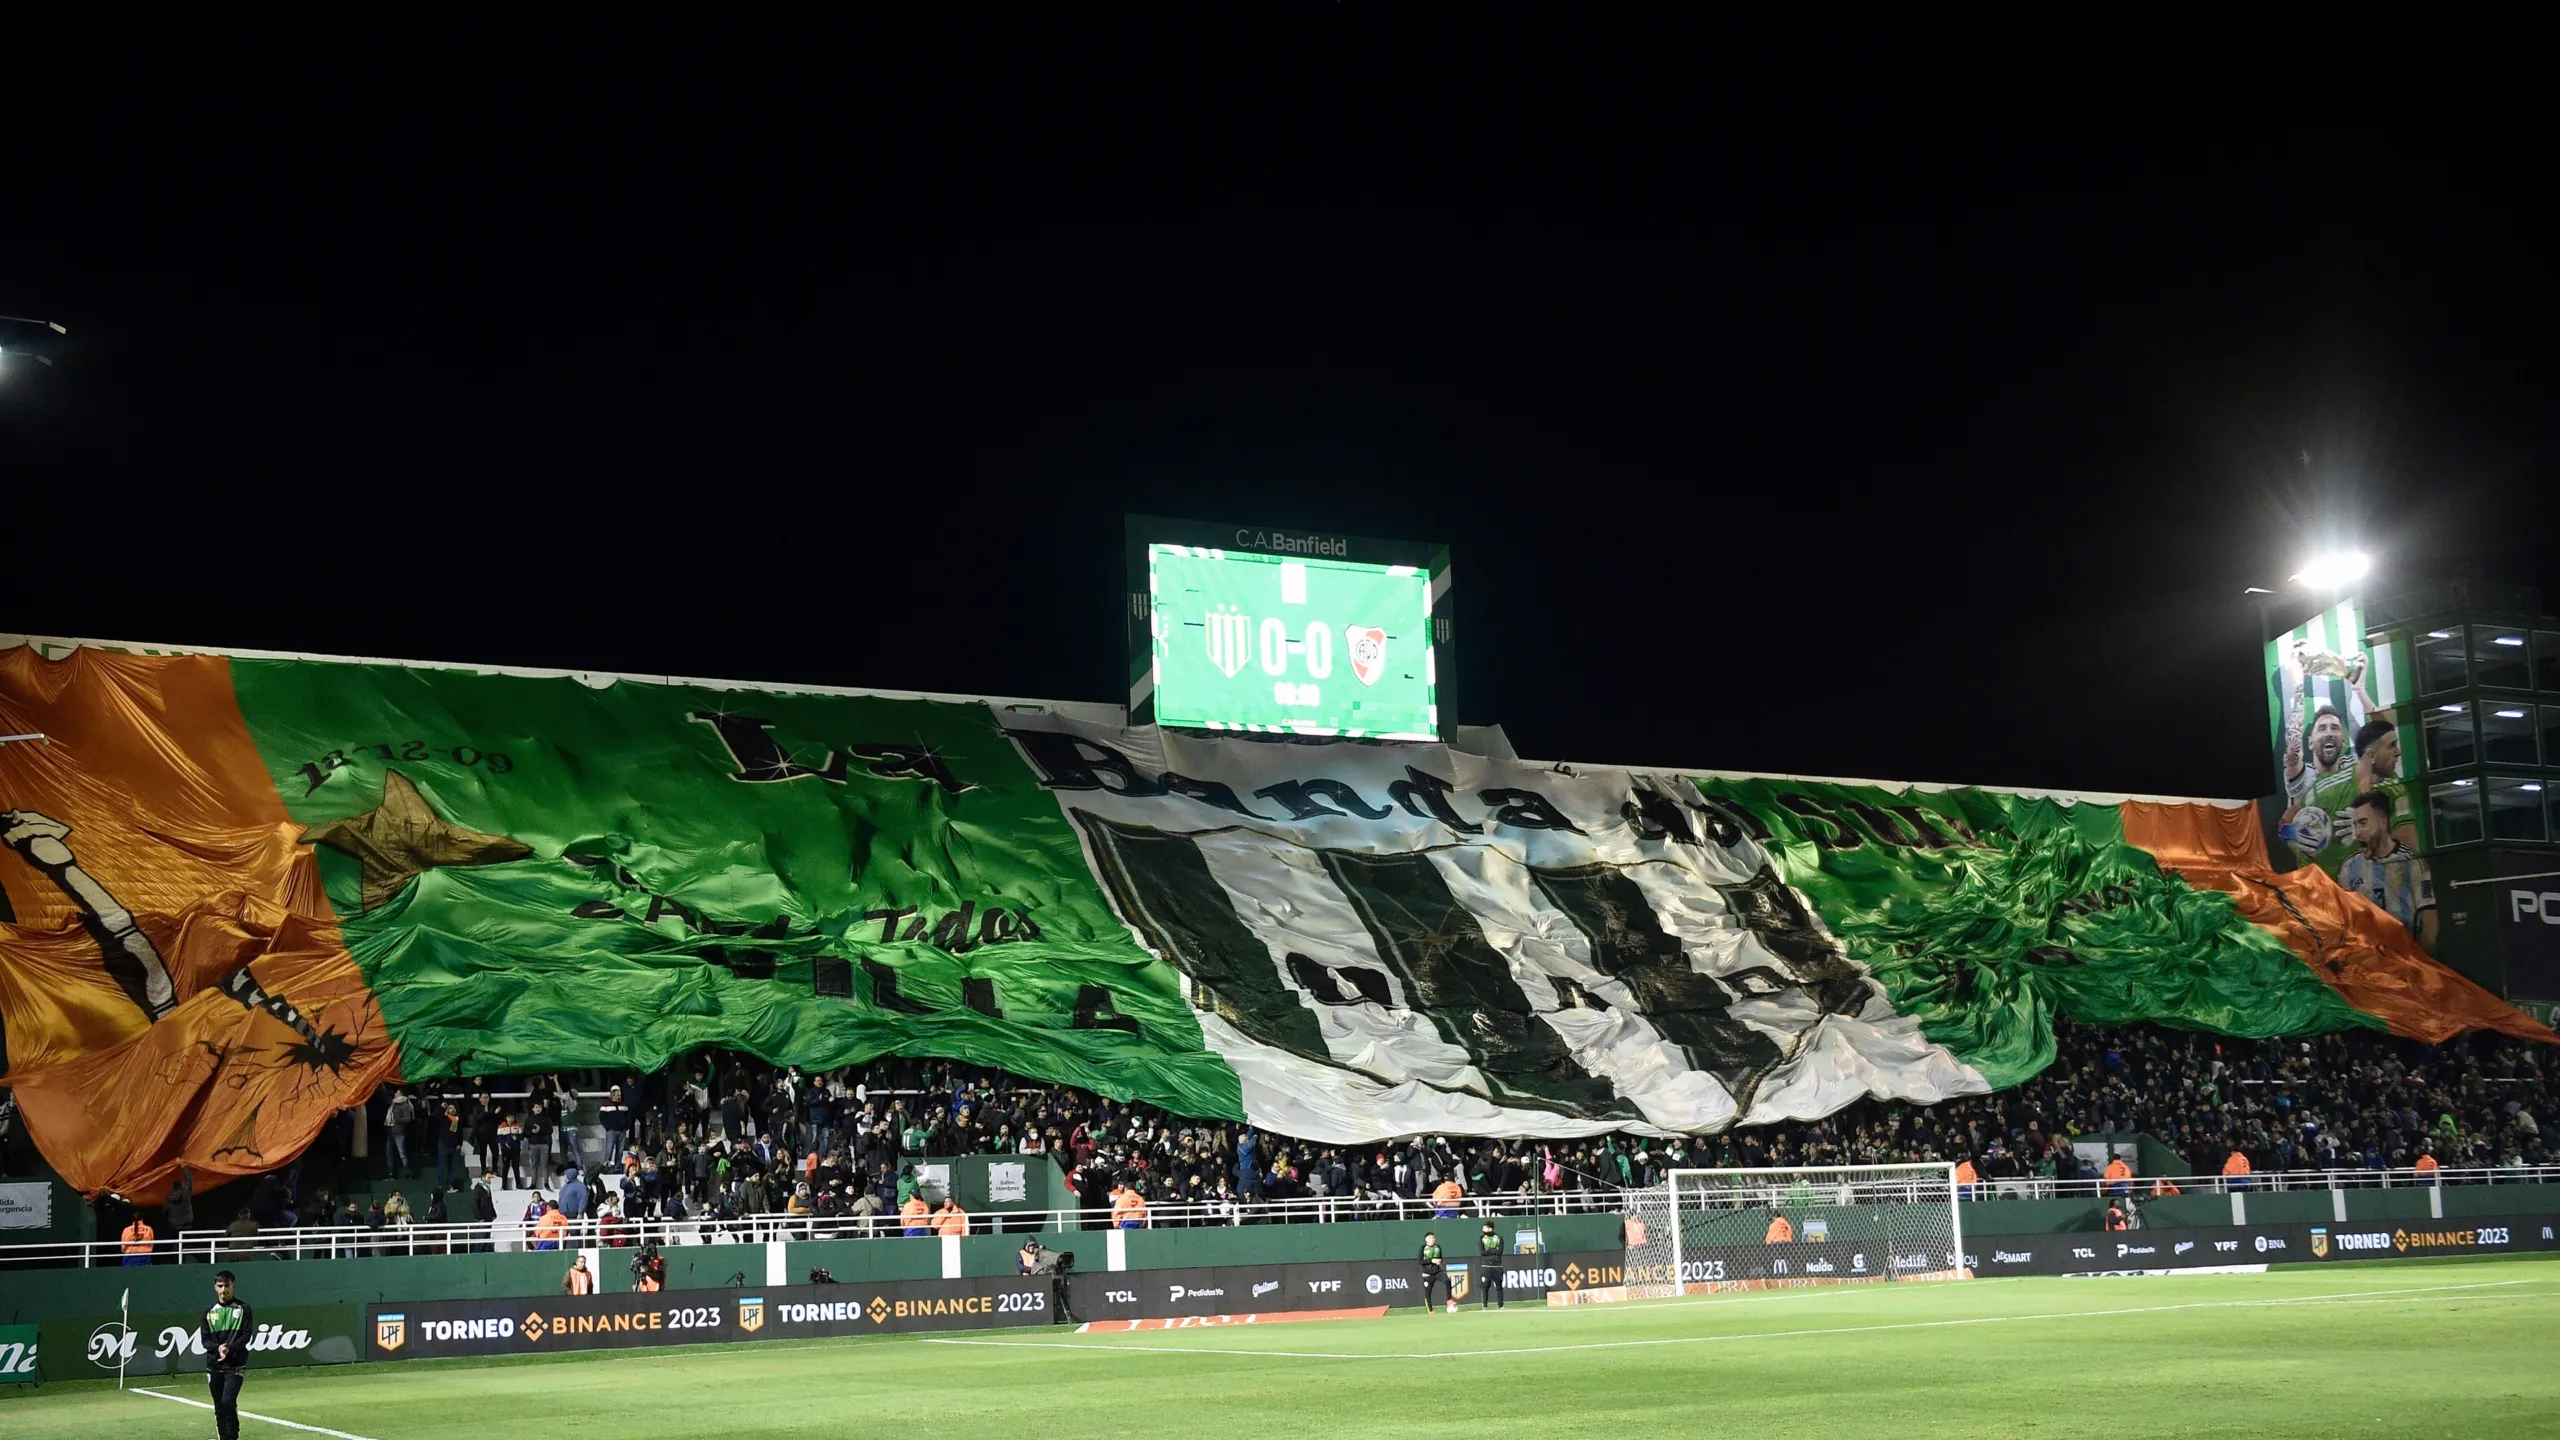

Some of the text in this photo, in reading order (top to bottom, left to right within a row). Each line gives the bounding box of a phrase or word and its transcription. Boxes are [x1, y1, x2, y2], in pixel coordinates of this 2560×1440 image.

[1236, 529, 1347, 556] C.A.Banfield
[686, 711, 980, 794] La
[1000, 729, 1592, 836] Banda
[2214, 1240, 2238, 1252] YPF
[2268, 1239, 2286, 1250] BNA
[2336, 1228, 2509, 1250] TORNEO BINANCE 2023
[2072, 1248, 2095, 1259] TCL
[1588, 1265, 1675, 1284] BINANCE
[1682, 1261, 1724, 1280] 2023
[1806, 1258, 1833, 1273] Naldo
[1308, 1280, 1342, 1293] YPF
[1385, 1278, 1408, 1290] BNA
[1105, 1291, 1137, 1303] TCL
[1188, 1288, 1224, 1298] PedidosYa
[778, 1292, 1045, 1322] TORNEO BINANCE 2023
[421, 1307, 721, 1341] TORNEO BINANCE 2023
